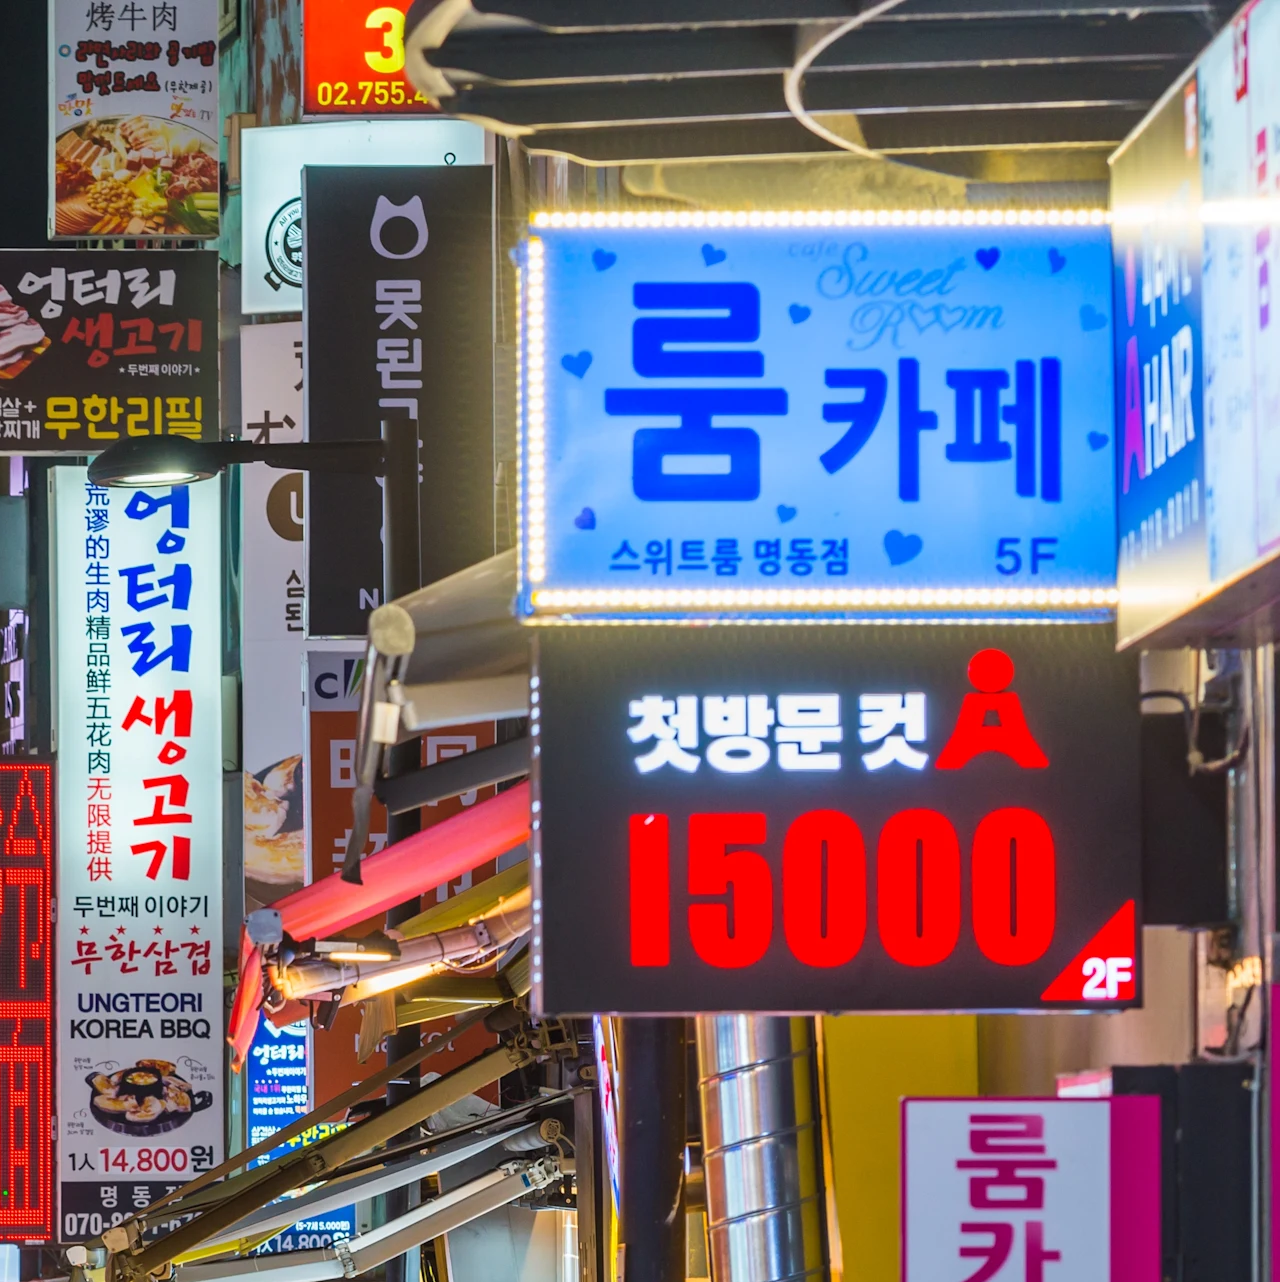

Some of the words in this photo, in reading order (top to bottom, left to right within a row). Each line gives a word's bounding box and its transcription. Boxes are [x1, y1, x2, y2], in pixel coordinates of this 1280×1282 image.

[86, 1, 178, 31] 烤牛肉
[17, 266, 177, 319] 엉터리
[61, 312, 204, 368] 생고기
[127, 363, 160, 376] 두번째
[161, 363, 193, 376] 이야기
[604, 281, 789, 502] 룸
[819, 356, 1063, 503] 카페
[45, 393, 204, 441] 무한리필
[609, 538, 743, 577] 스위트룸
[753, 537, 851, 578] 명동점
[994, 537, 1059, 577] 5F
[626, 692, 843, 774] 첫방문
[857, 692, 929, 772] 컷
[72, 895, 141, 919] 두번째
[144, 895, 209, 919] 이야기
[628, 807, 1056, 969] 15000
[70, 934, 212, 978] 무한삼겹
[1082, 957, 1133, 1000] 2F
[77, 993, 203, 1014] UNGTEORI
[70, 1019, 157, 1040] KOREA
[160, 1019, 211, 1041] BBQ
